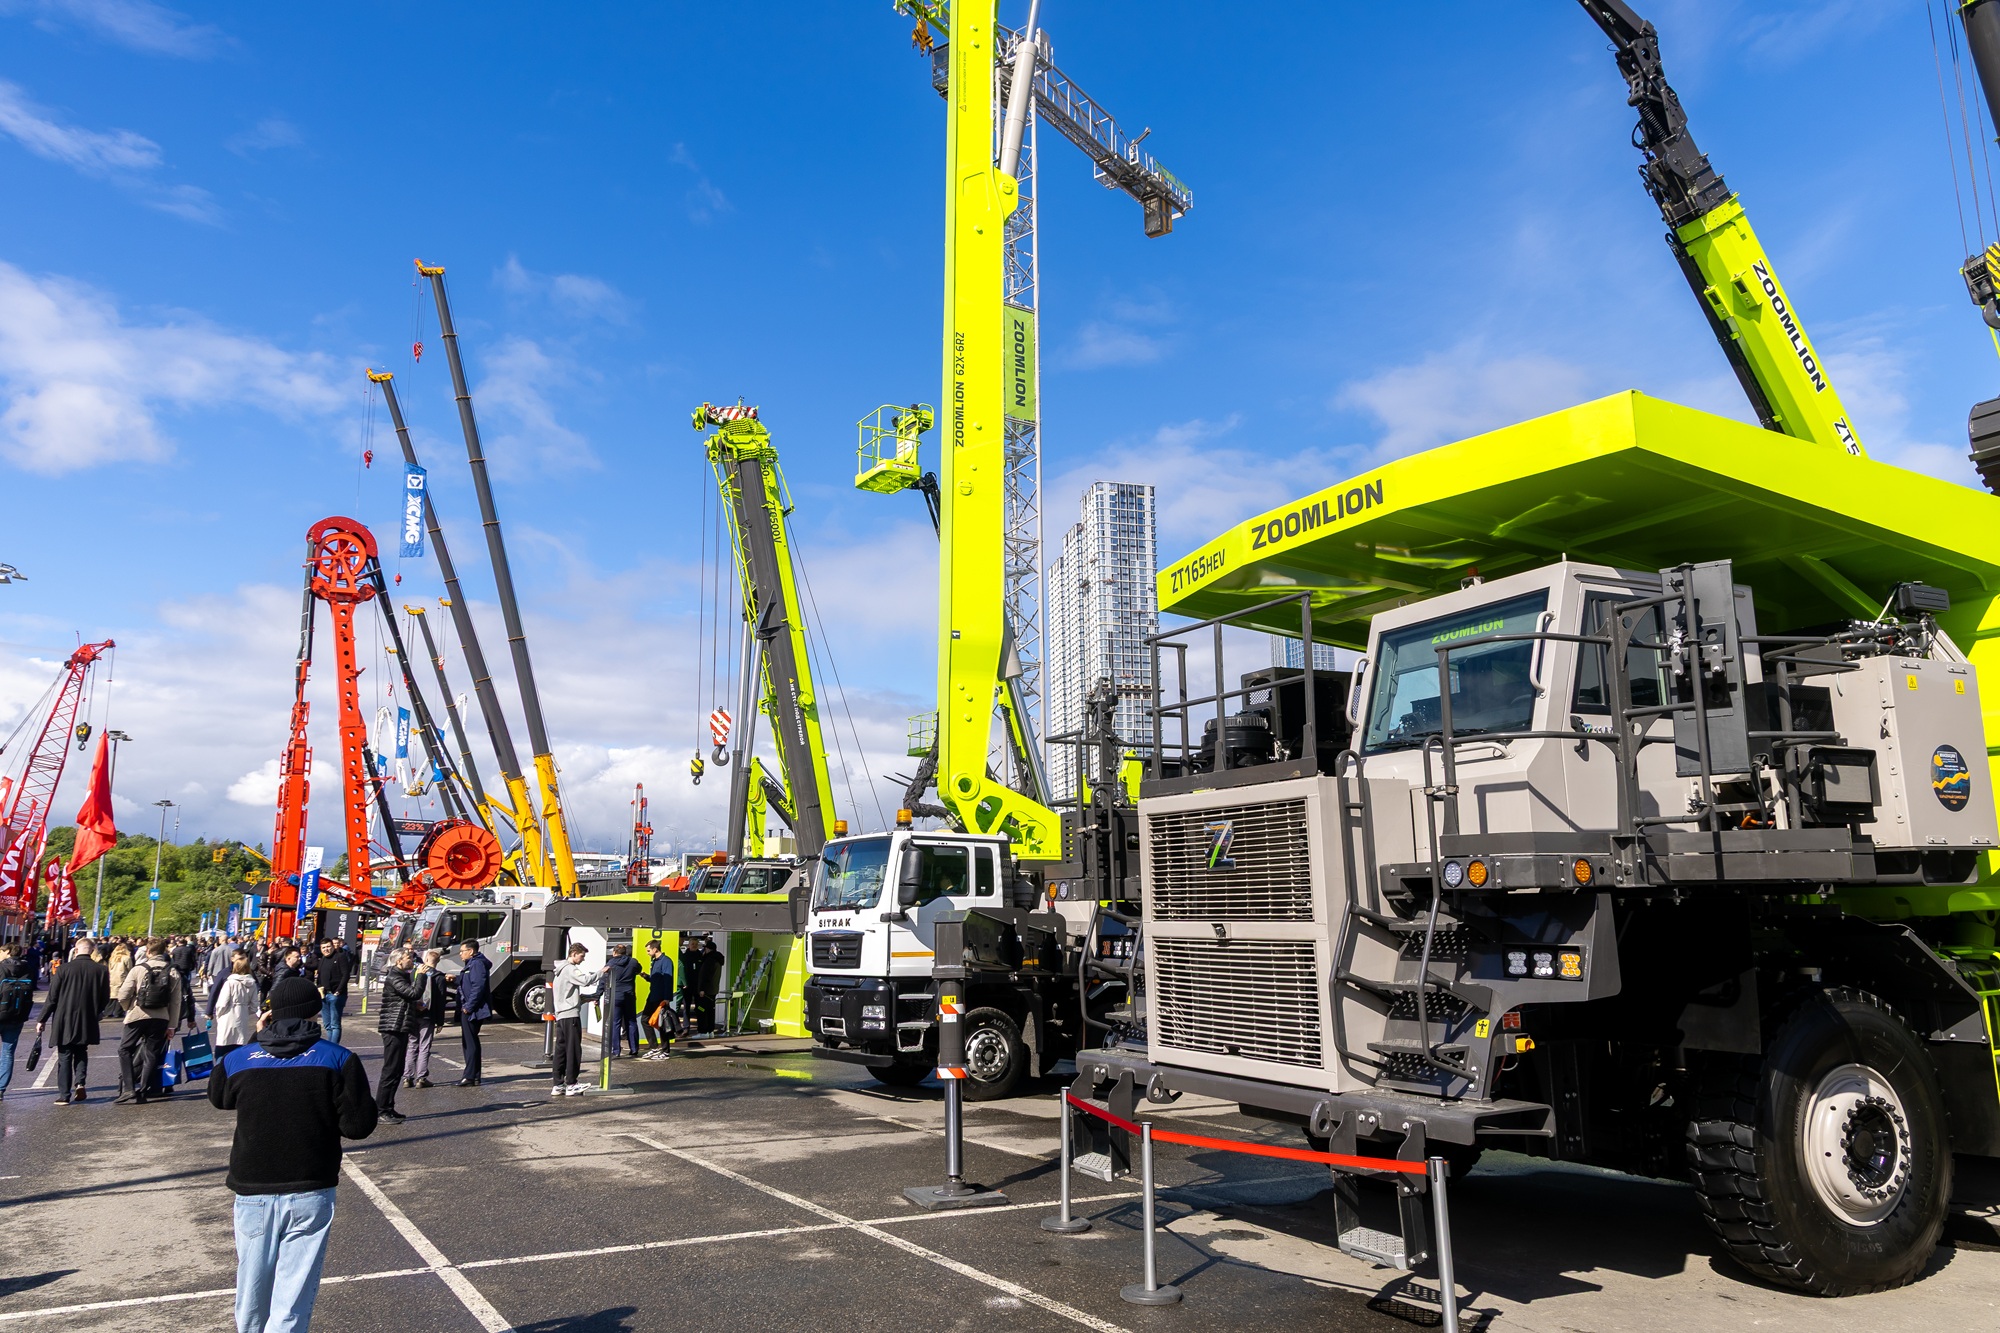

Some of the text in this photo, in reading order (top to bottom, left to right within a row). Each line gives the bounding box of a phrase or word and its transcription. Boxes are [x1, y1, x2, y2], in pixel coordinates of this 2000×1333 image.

[1752, 259, 1826, 393] ZOOMLION
[1013, 319, 1026, 408] ZOOMLION
[955, 332, 965, 448] ZOOMLION 62X-6RZ
[404, 493, 421, 543] XCMG
[1251, 478, 1384, 551] ZOOMLION
[1170, 549, 1226, 594] ZT165HEV
[1431, 618, 1504, 645] ZOOMLION
[398, 717, 408, 747] XCMG
[516, 861, 527, 884] VOLVO
[818, 918, 852, 928] SITRAK
